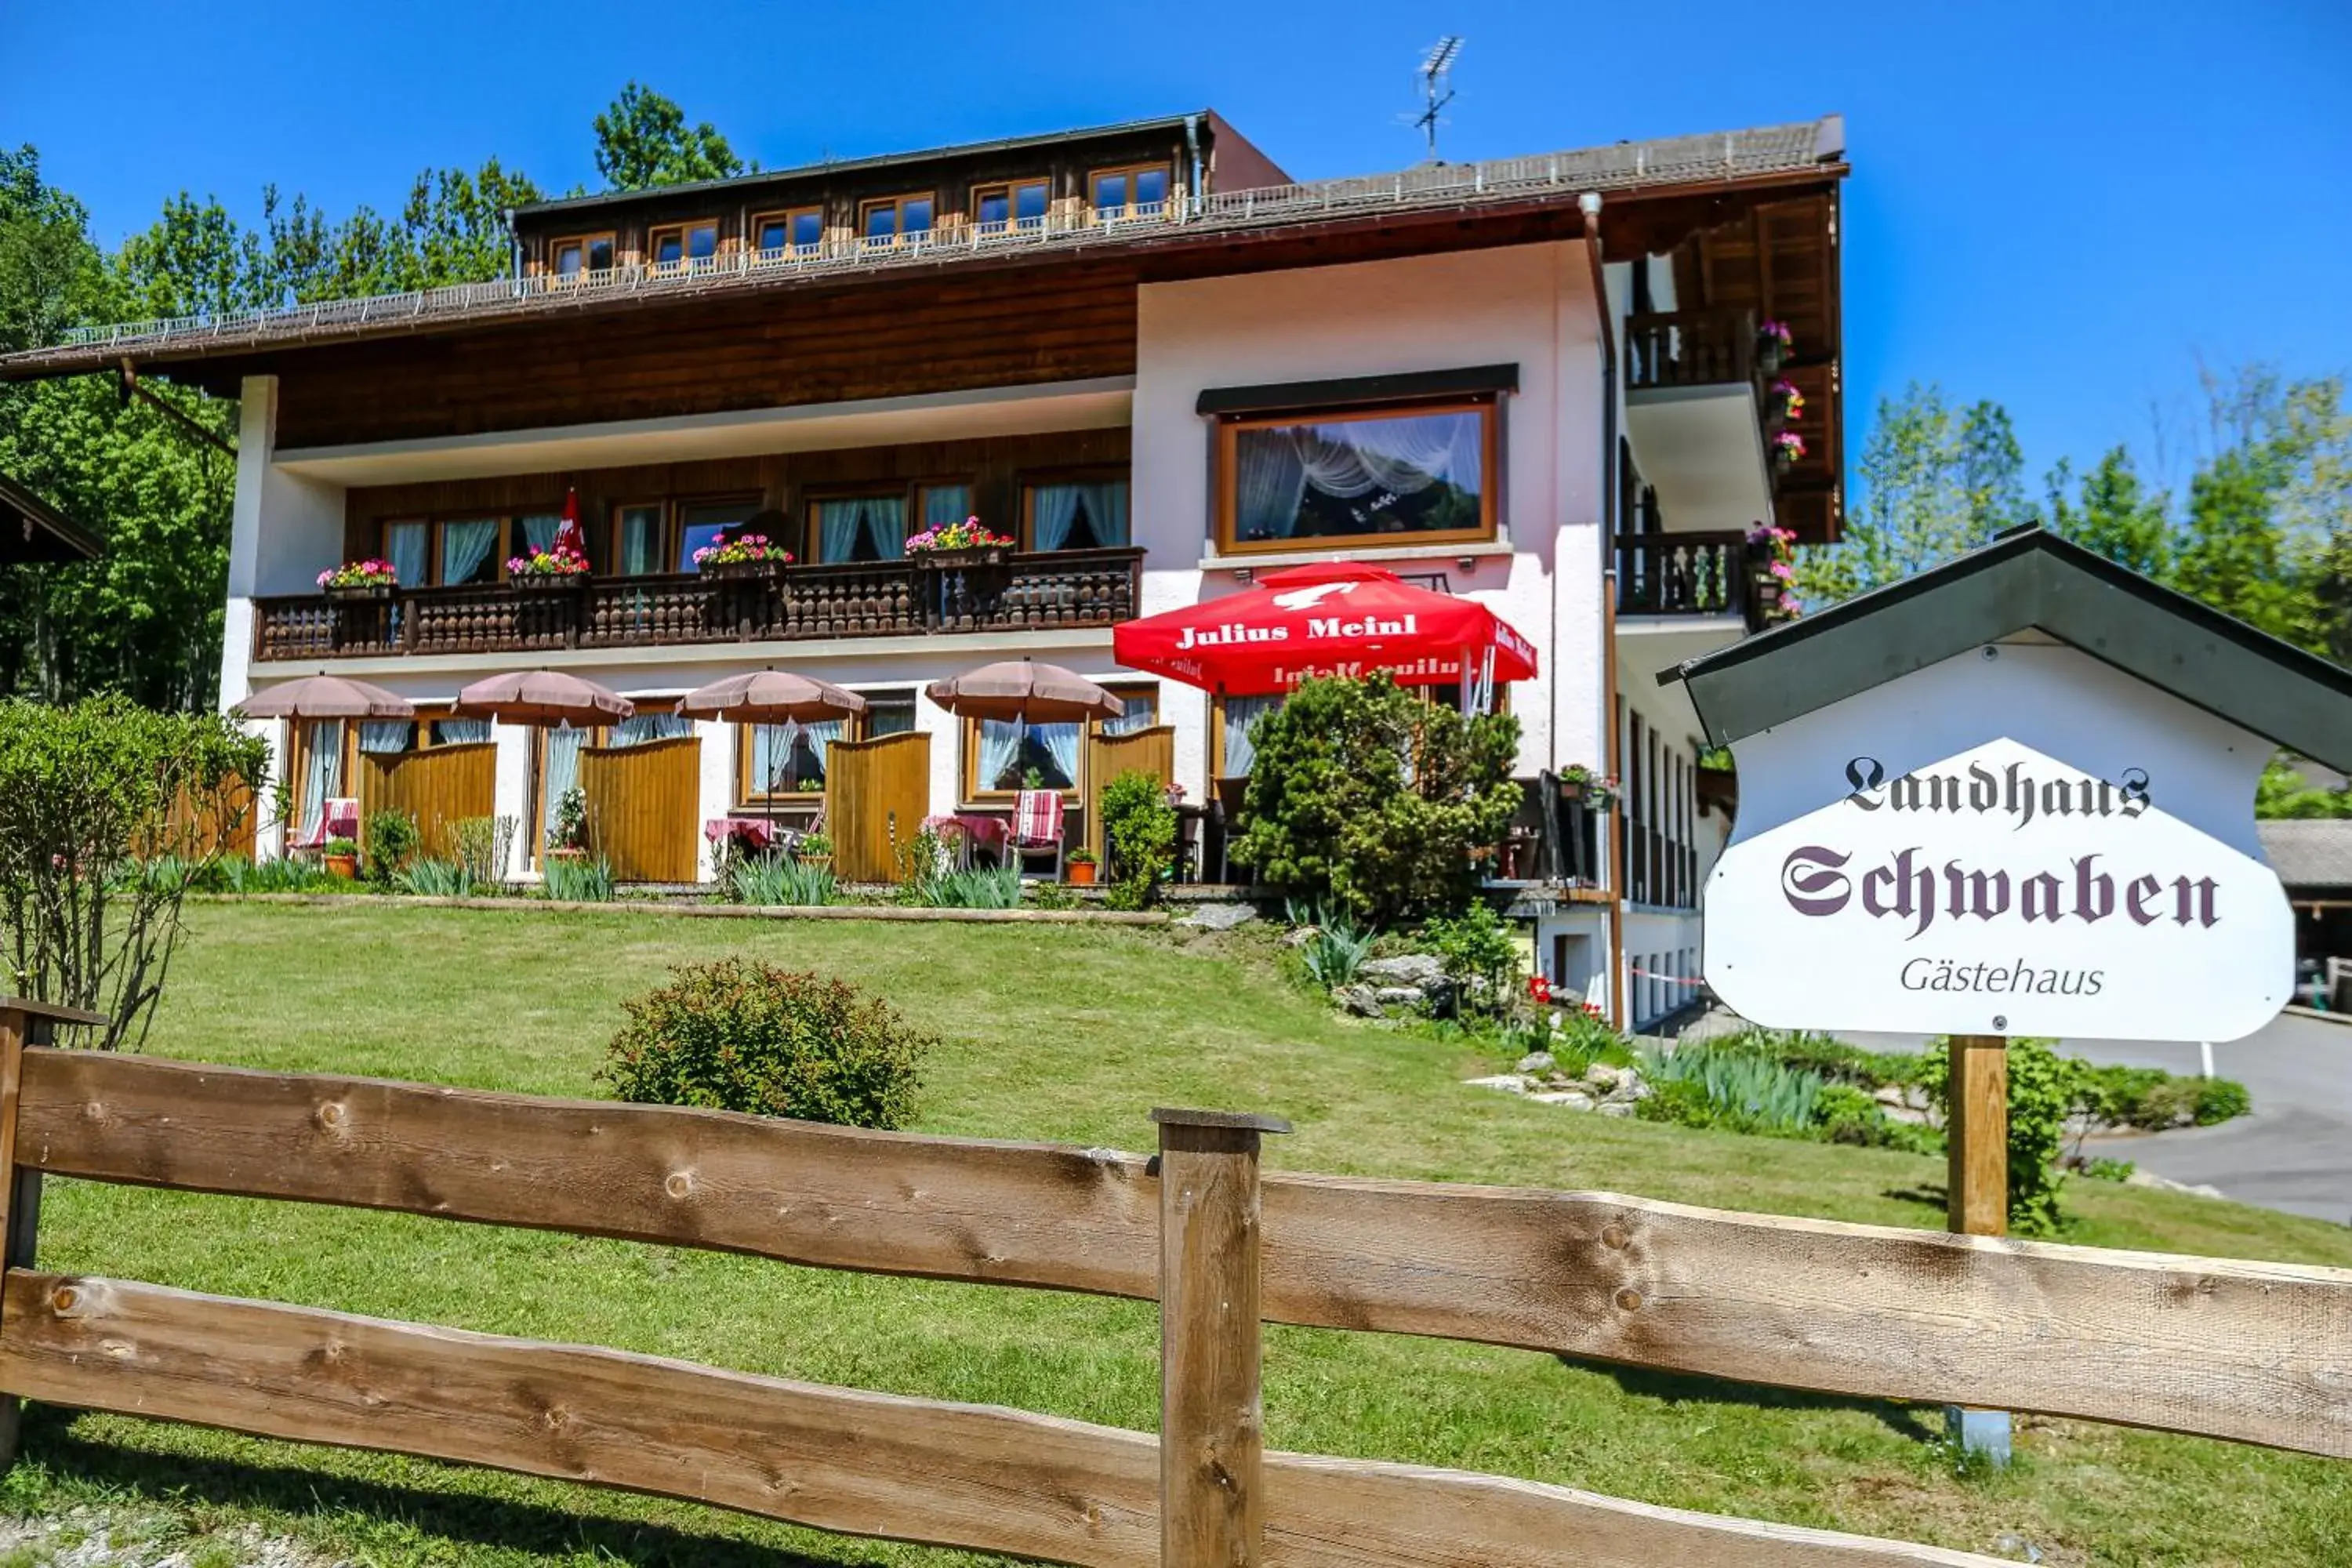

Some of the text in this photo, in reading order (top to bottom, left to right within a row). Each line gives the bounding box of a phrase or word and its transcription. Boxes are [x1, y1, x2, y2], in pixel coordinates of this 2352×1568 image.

[1175, 614, 1417, 649] Julius Meinl
[1844, 756, 2151, 831] Landhaus
[1780, 845, 2222, 941] Schwaben
[1900, 957, 2105, 996] Gästehaus
